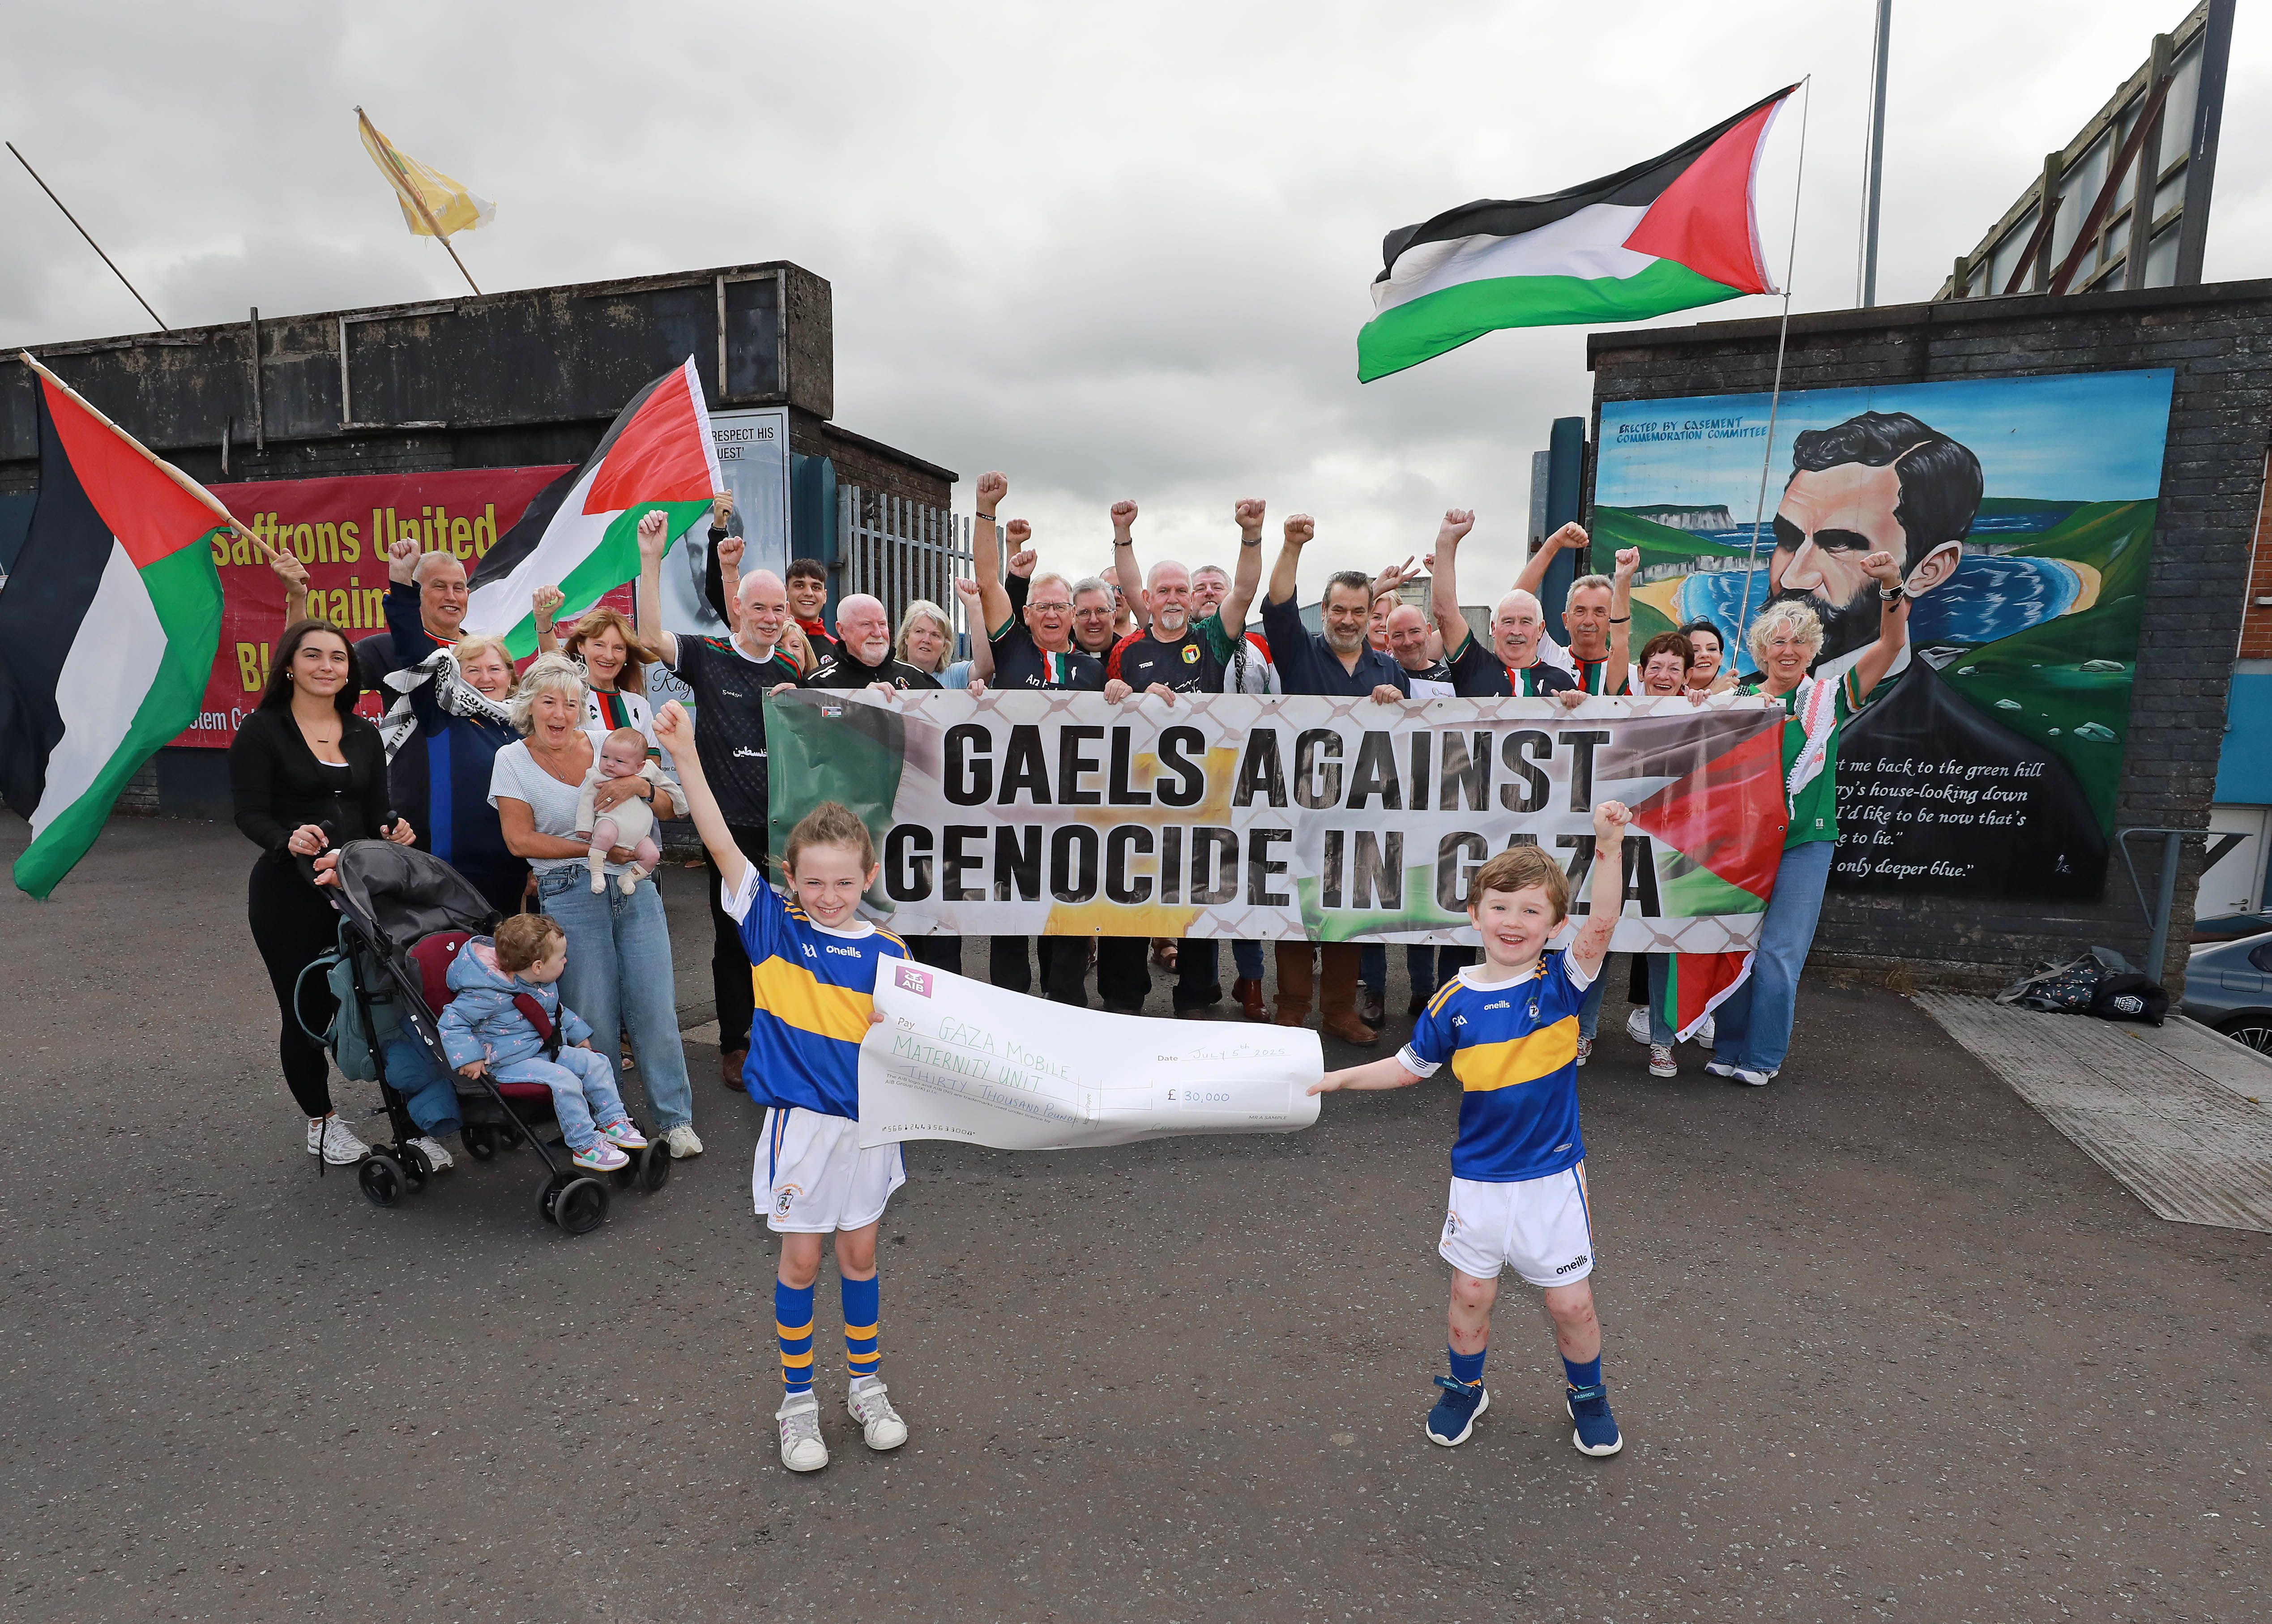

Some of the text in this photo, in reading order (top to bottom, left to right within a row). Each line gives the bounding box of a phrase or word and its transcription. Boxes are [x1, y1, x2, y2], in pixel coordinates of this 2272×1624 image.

[758, 427, 774, 439] HIS
[1619, 416, 1743, 434] ERECTED BY CASEMENT
[1617, 426, 1768, 443] COMMEMORATION COMMITTEE
[717, 446, 744, 459] UEST'
[211, 503, 498, 567] Saffrons United
[286, 576, 385, 629] gain
[944, 723, 1610, 813] GAELS AGAINST
[1849, 761, 1872, 772] me
[1877, 758, 1915, 777] back
[1918, 761, 1934, 774] to
[1939, 759, 1964, 774] the
[1965, 766, 2010, 781] green
[2014, 761, 2045, 777] hill
[1869, 782, 1979, 804] house-looking
[1982, 786, 2028, 802] down
[1863, 806, 1892, 825] like
[1896, 810, 1912, 822] to
[1918, 808, 1935, 823] be
[1939, 813, 1974, 825] now
[1979, 810, 2027, 826] that's
[1852, 832, 1868, 844] to
[884, 823, 1293, 907] GENOCIDE
[1323, 830, 1403, 909] IN
[1837, 857, 1871, 877] only
[1875, 859, 1928, 880] deeper
[902, 979, 924, 992] AIB
[897, 1017, 915, 1030] Pay
[939, 1017, 994, 1054] GAZA
[1254, 1048, 1285, 1057] 2025
[899, 1065, 967, 1093] THIRTY
[978, 1085, 1039, 1113] THOUSAND
[1167, 1089, 1176, 1101] £
[1184, 1090, 1230, 1103] 30,000
[963, 1095, 993, 1107] trademarks
[1025, 1113, 1043, 1121] licence
[1443, 1380, 1458, 1389] FASHION
[1574, 1391, 1595, 1400] FASHION
